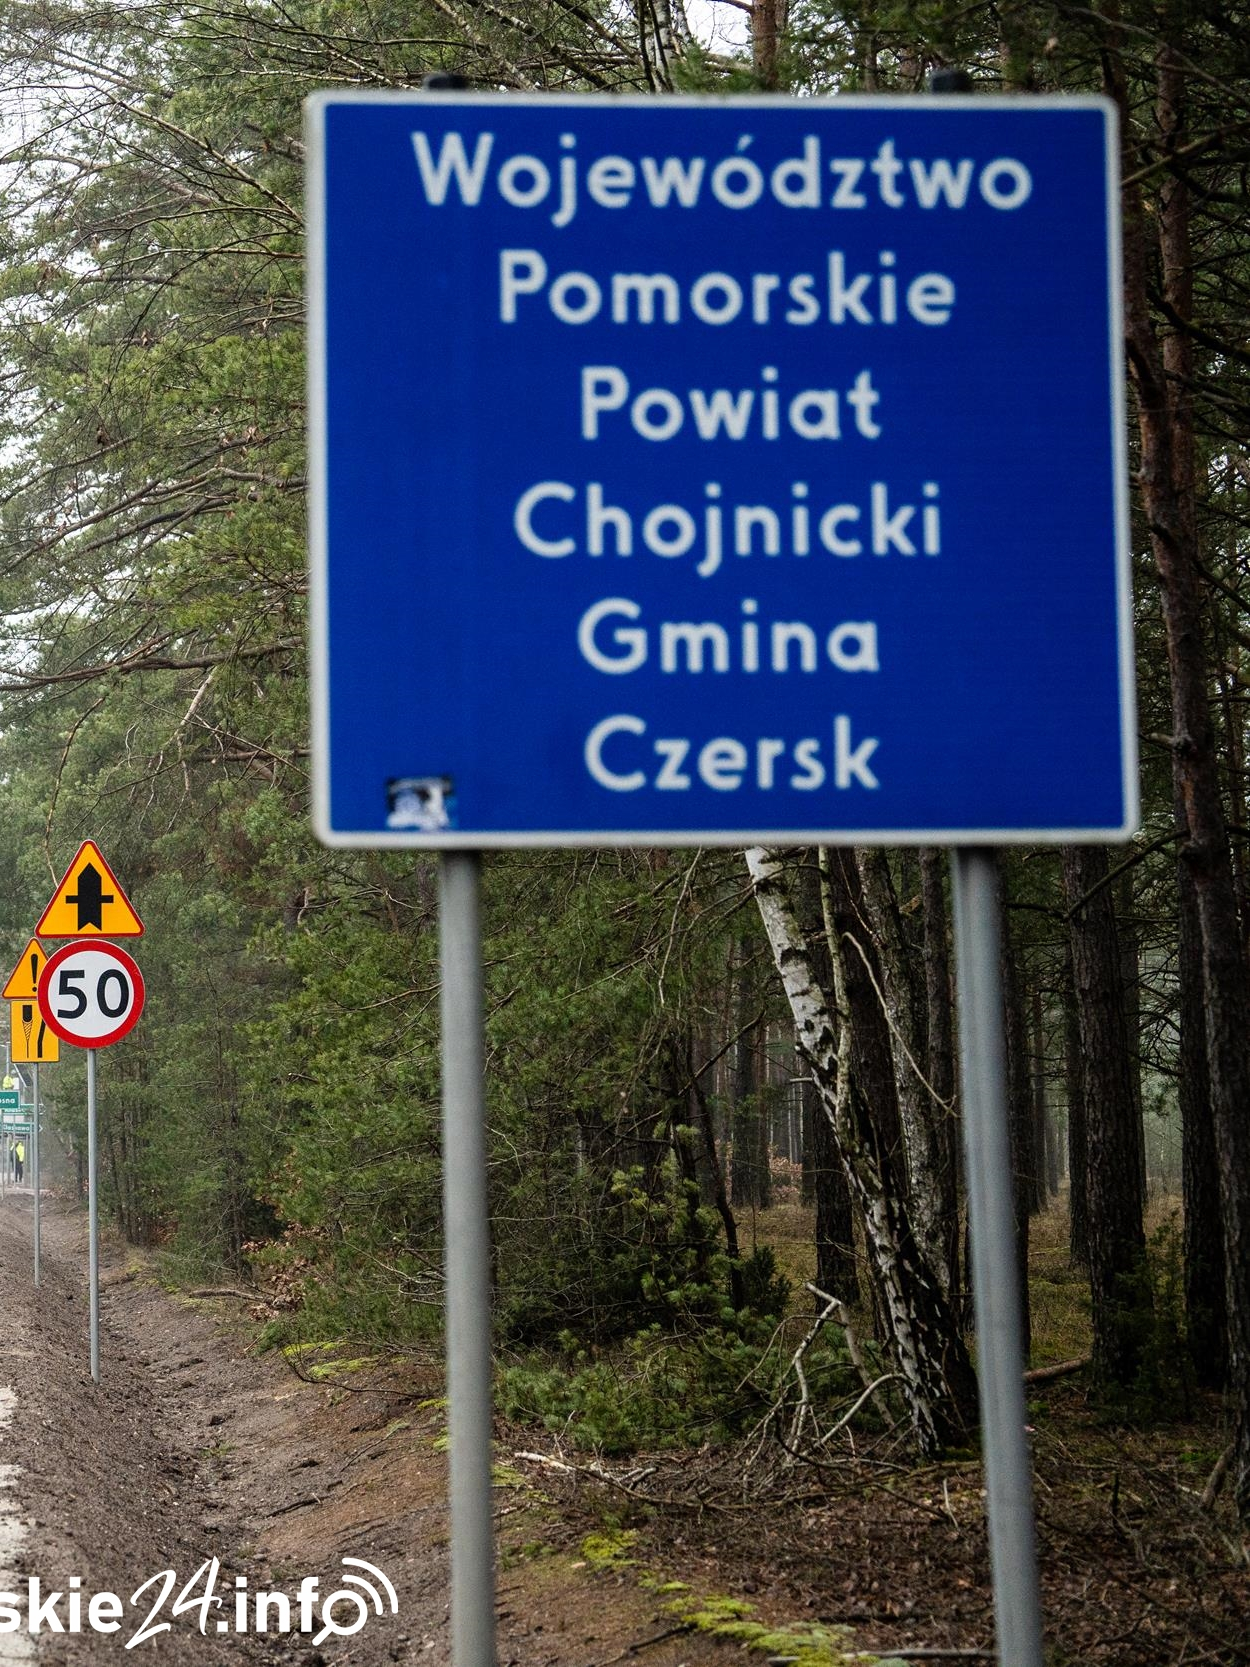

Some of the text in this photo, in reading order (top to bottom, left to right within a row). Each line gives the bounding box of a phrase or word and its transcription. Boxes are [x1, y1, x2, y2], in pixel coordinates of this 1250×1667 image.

[412, 132, 1033, 227] Województwo
[500, 249, 956, 325] Pomorskie
[582, 366, 882, 441] Powiat
[514, 482, 940, 577] Chojnicki
[578, 598, 880, 674] Gmina
[584, 715, 880, 791] Czersk
[57, 969, 129, 1019] 50
